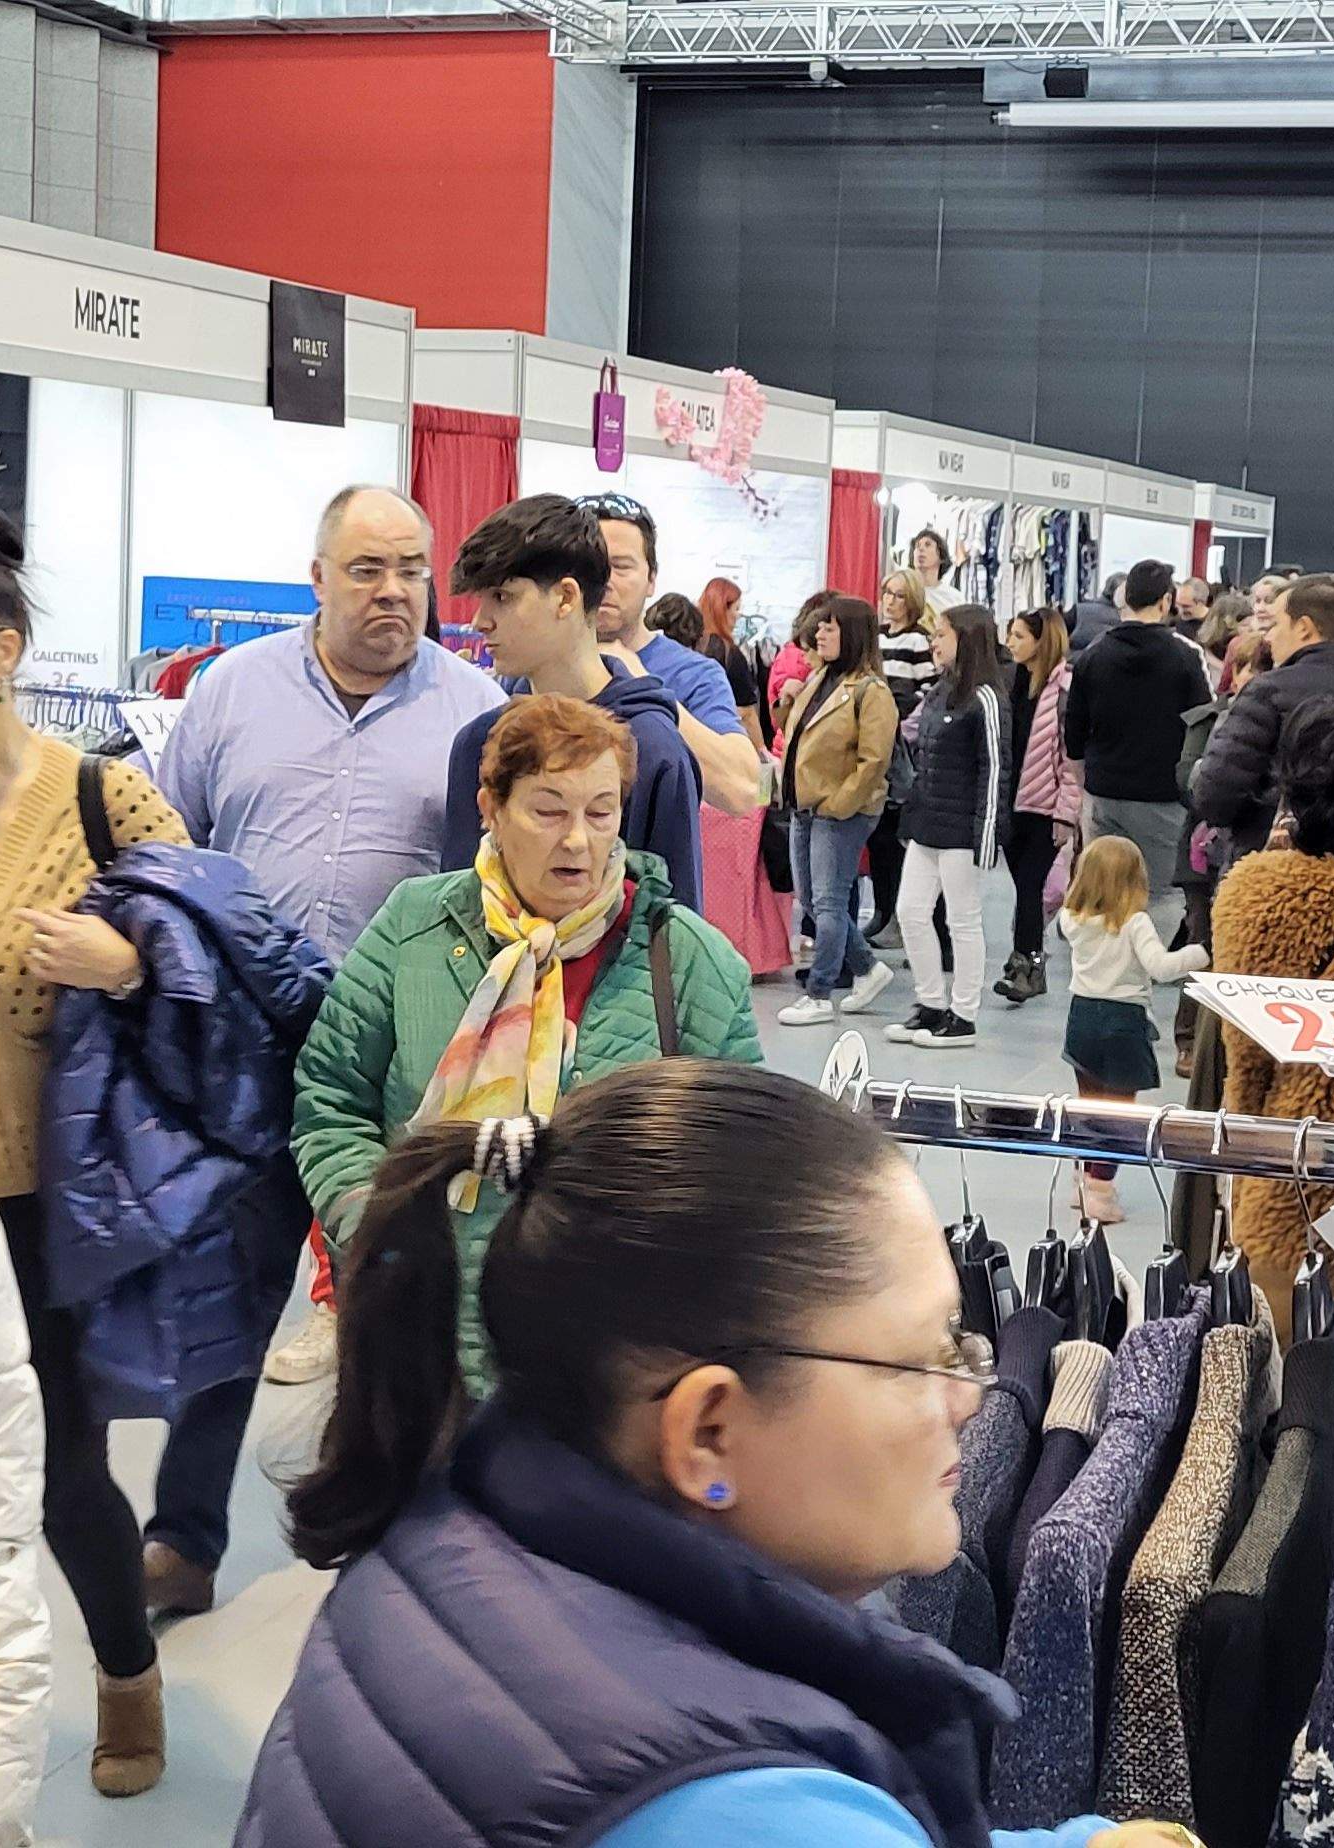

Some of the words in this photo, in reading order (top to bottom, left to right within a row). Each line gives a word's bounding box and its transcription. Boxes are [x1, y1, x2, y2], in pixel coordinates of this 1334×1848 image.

[74, 286, 141, 340] MIRATE
[292, 336, 329, 358] MIRATE
[31, 650, 99, 666] CALCETINES
